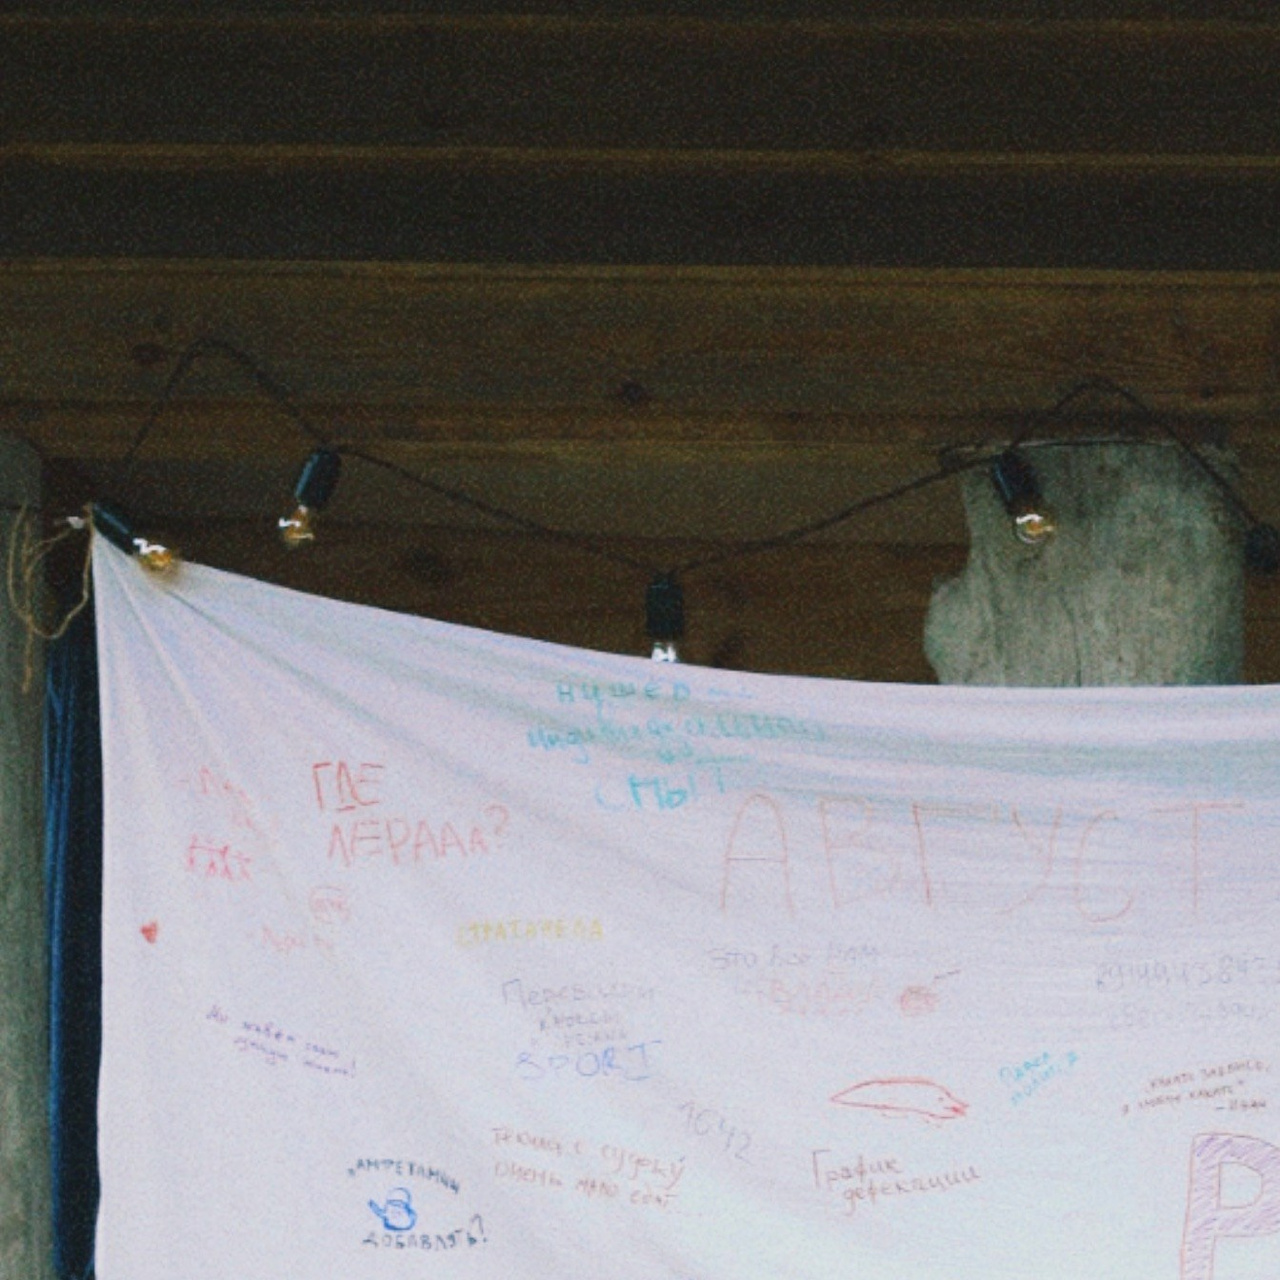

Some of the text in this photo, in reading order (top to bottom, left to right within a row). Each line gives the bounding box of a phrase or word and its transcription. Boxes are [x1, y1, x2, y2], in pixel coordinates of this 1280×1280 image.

[311, 760, 386, 812] ГДЕ
[720, 792, 1245, 922] АВГУСТ
[812, 1149, 904, 1189] График
